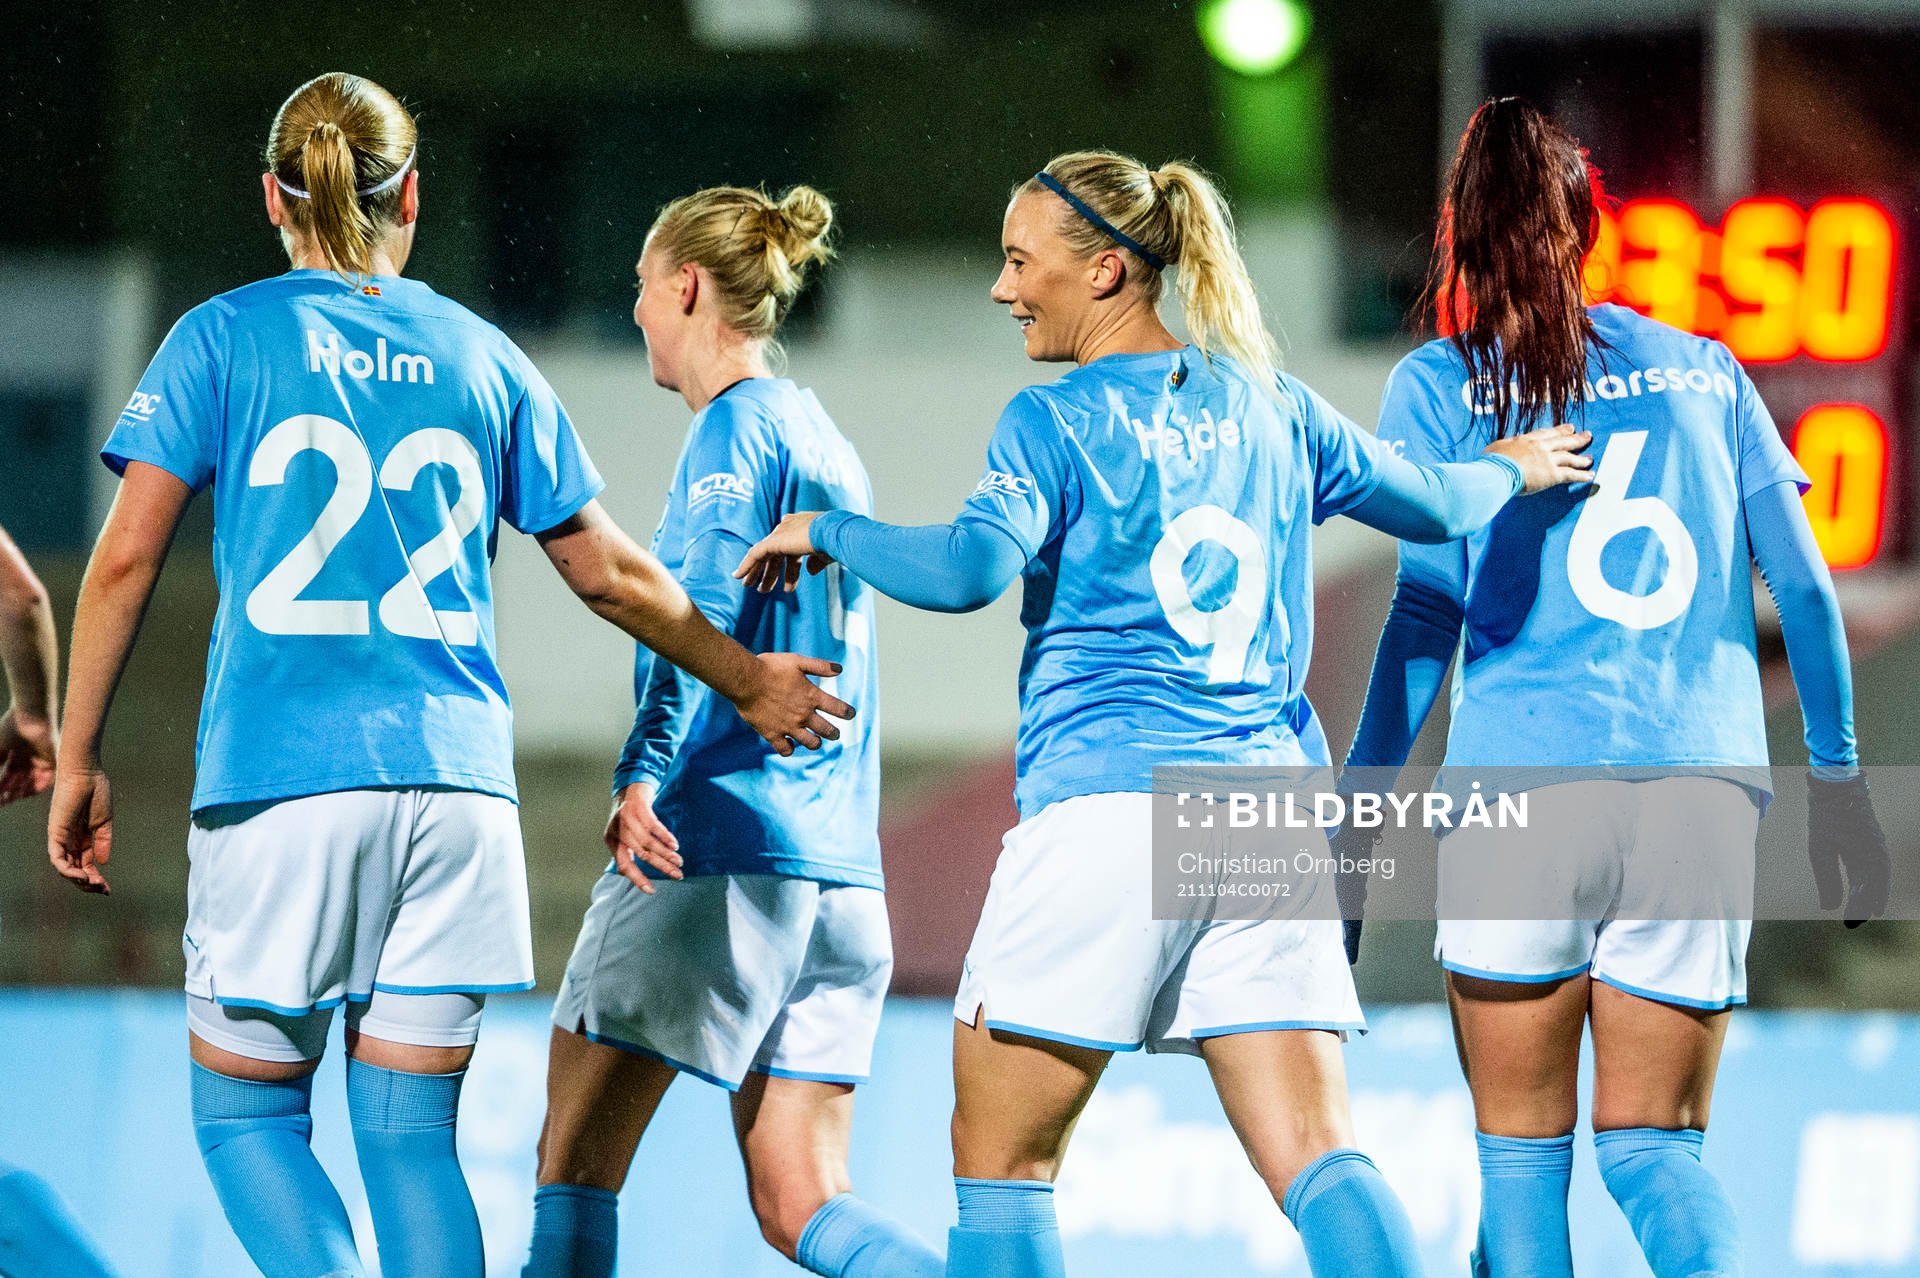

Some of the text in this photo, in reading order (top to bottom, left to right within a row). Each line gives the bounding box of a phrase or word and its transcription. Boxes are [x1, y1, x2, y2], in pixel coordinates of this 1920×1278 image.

[307, 329, 434, 385] Holm
[1461, 366, 1737, 415] Gnarsson
[1132, 407, 1241, 469] Hejde
[246, 413, 487, 648] 22
[1567, 430, 1698, 631] 6
[1150, 504, 1267, 686] 9
